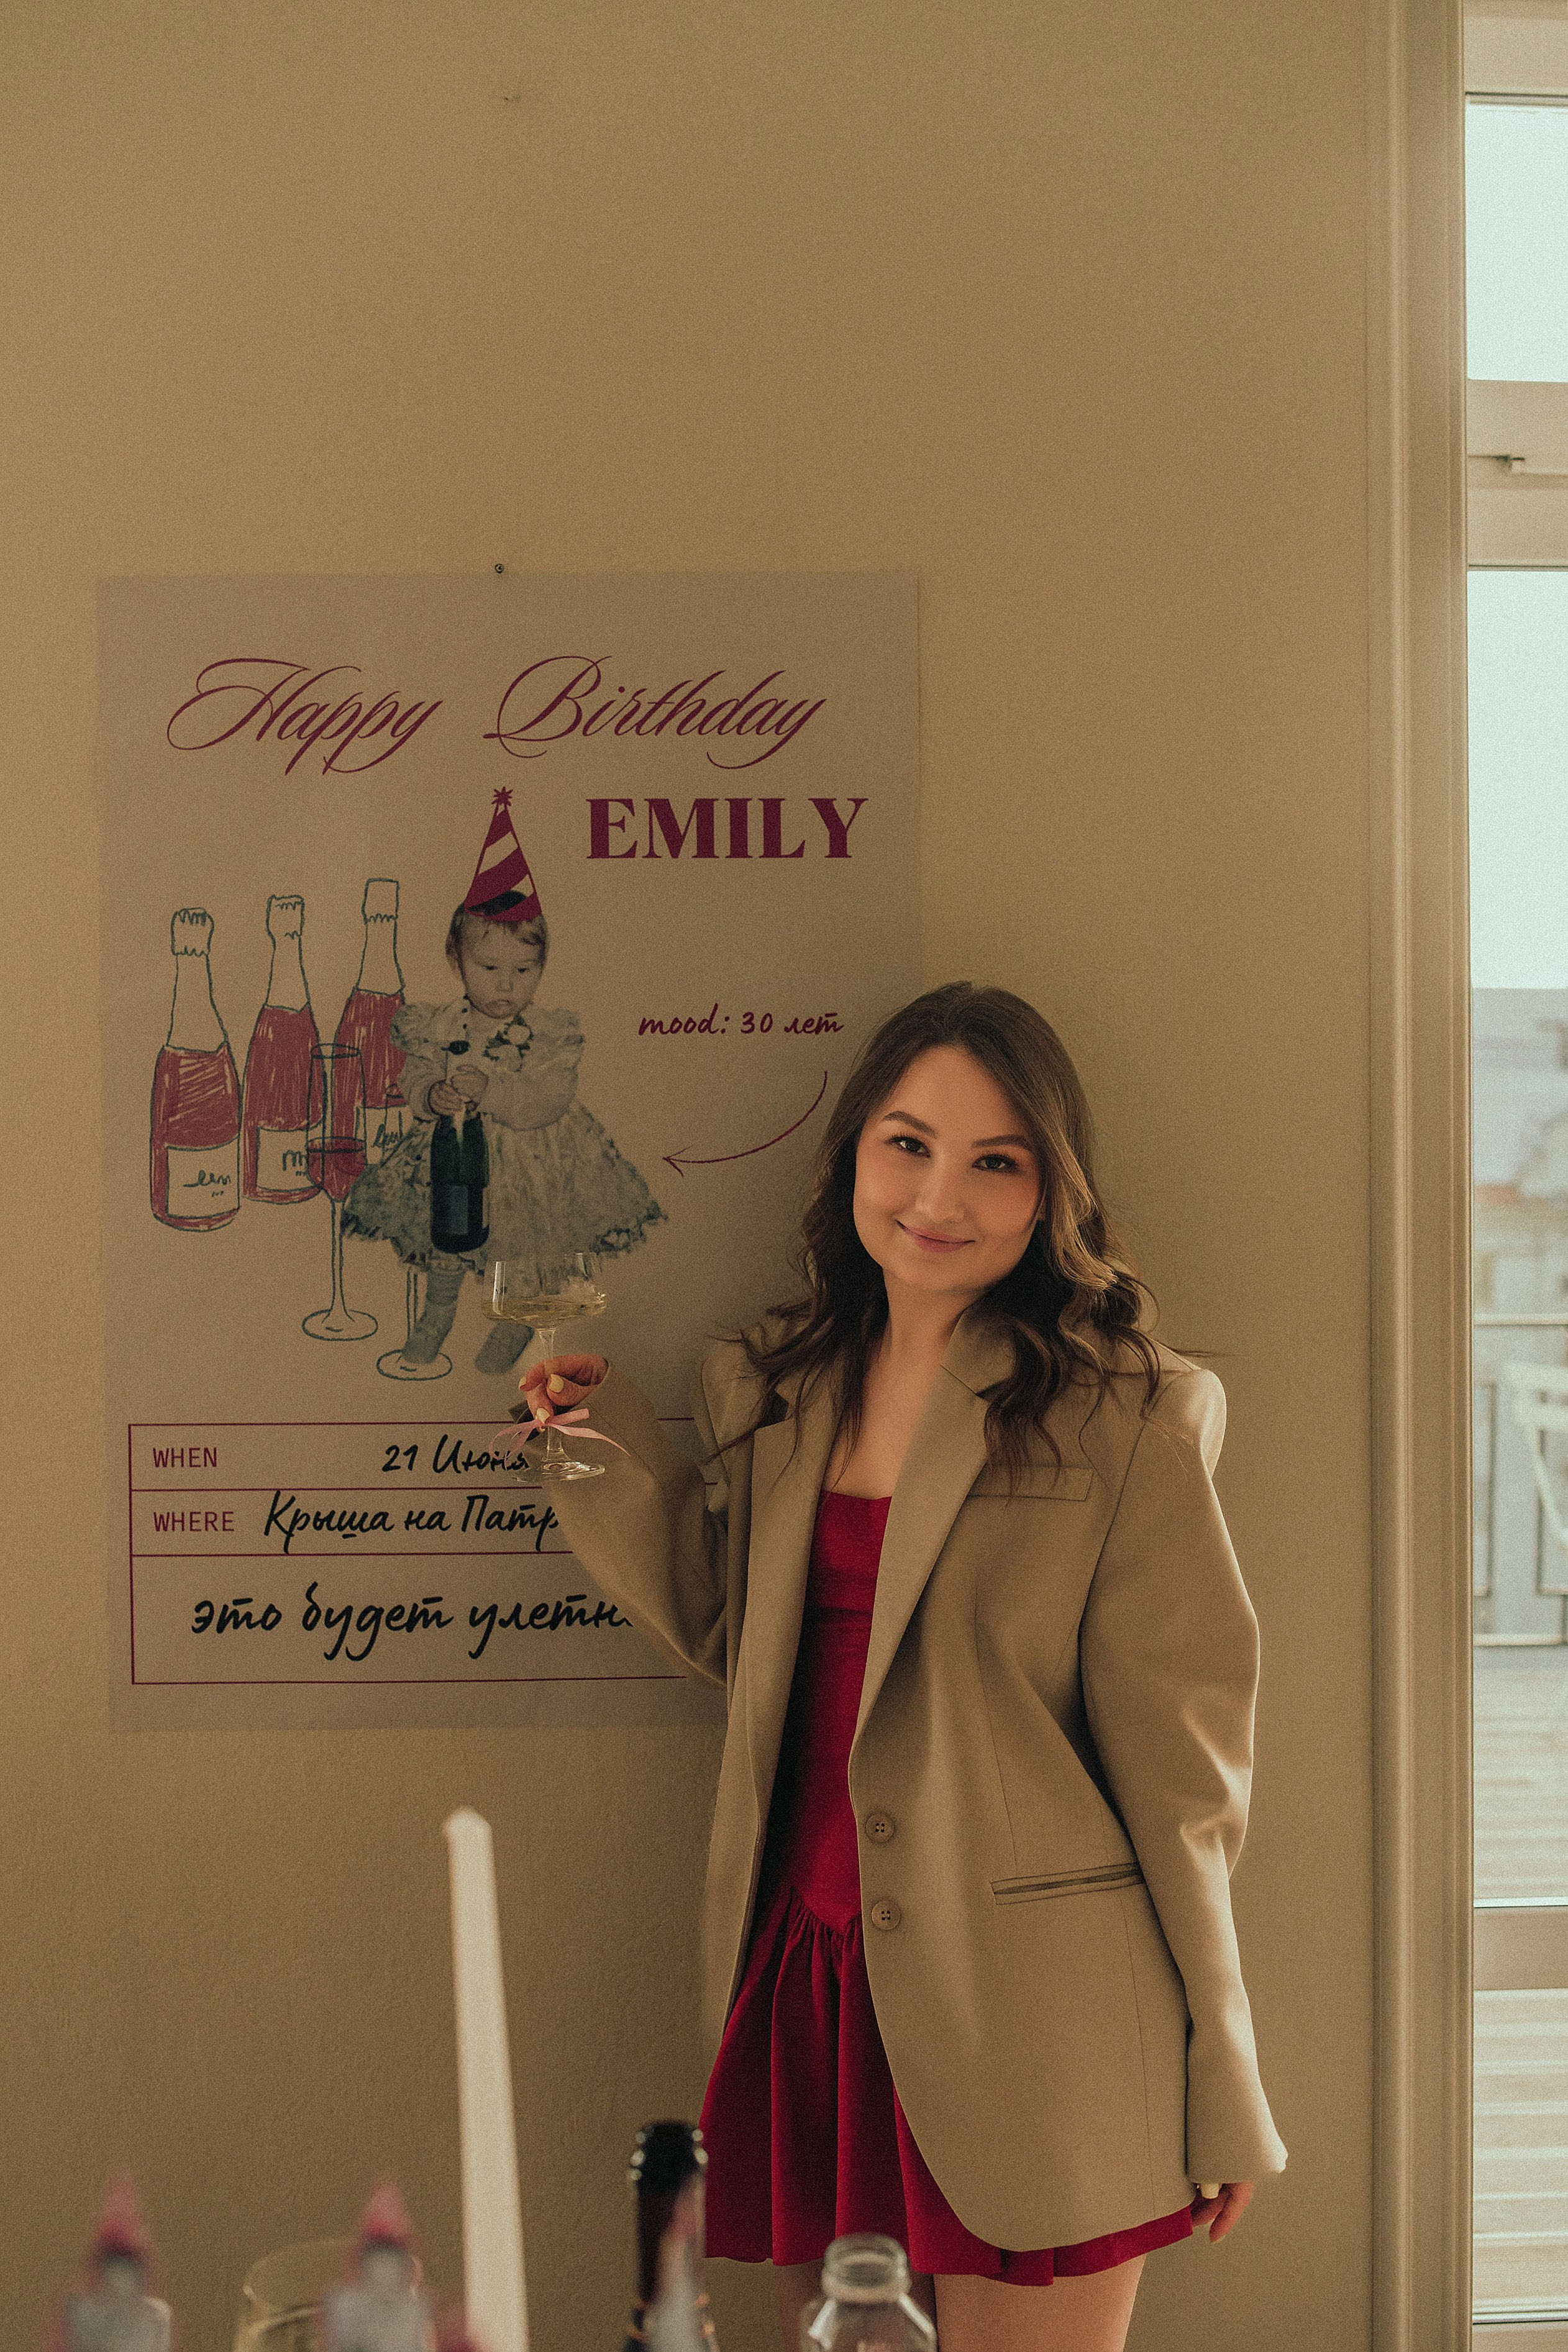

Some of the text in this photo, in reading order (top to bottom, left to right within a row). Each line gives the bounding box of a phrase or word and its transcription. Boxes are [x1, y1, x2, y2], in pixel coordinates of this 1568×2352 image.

[166, 655, 826, 776] Happy Birthday
[585, 798, 869, 860] EMILY
[637, 1003, 845, 1036] mood: 30 лет
[152, 1447, 218, 1468] WHEN
[381, 1434, 530, 1474] 21 Июня
[153, 1511, 235, 1532] WHERE
[263, 1490, 395, 1554] Крыша
[404, 1510, 452, 1533] на
[191, 1581, 633, 1661] это будет улетн
